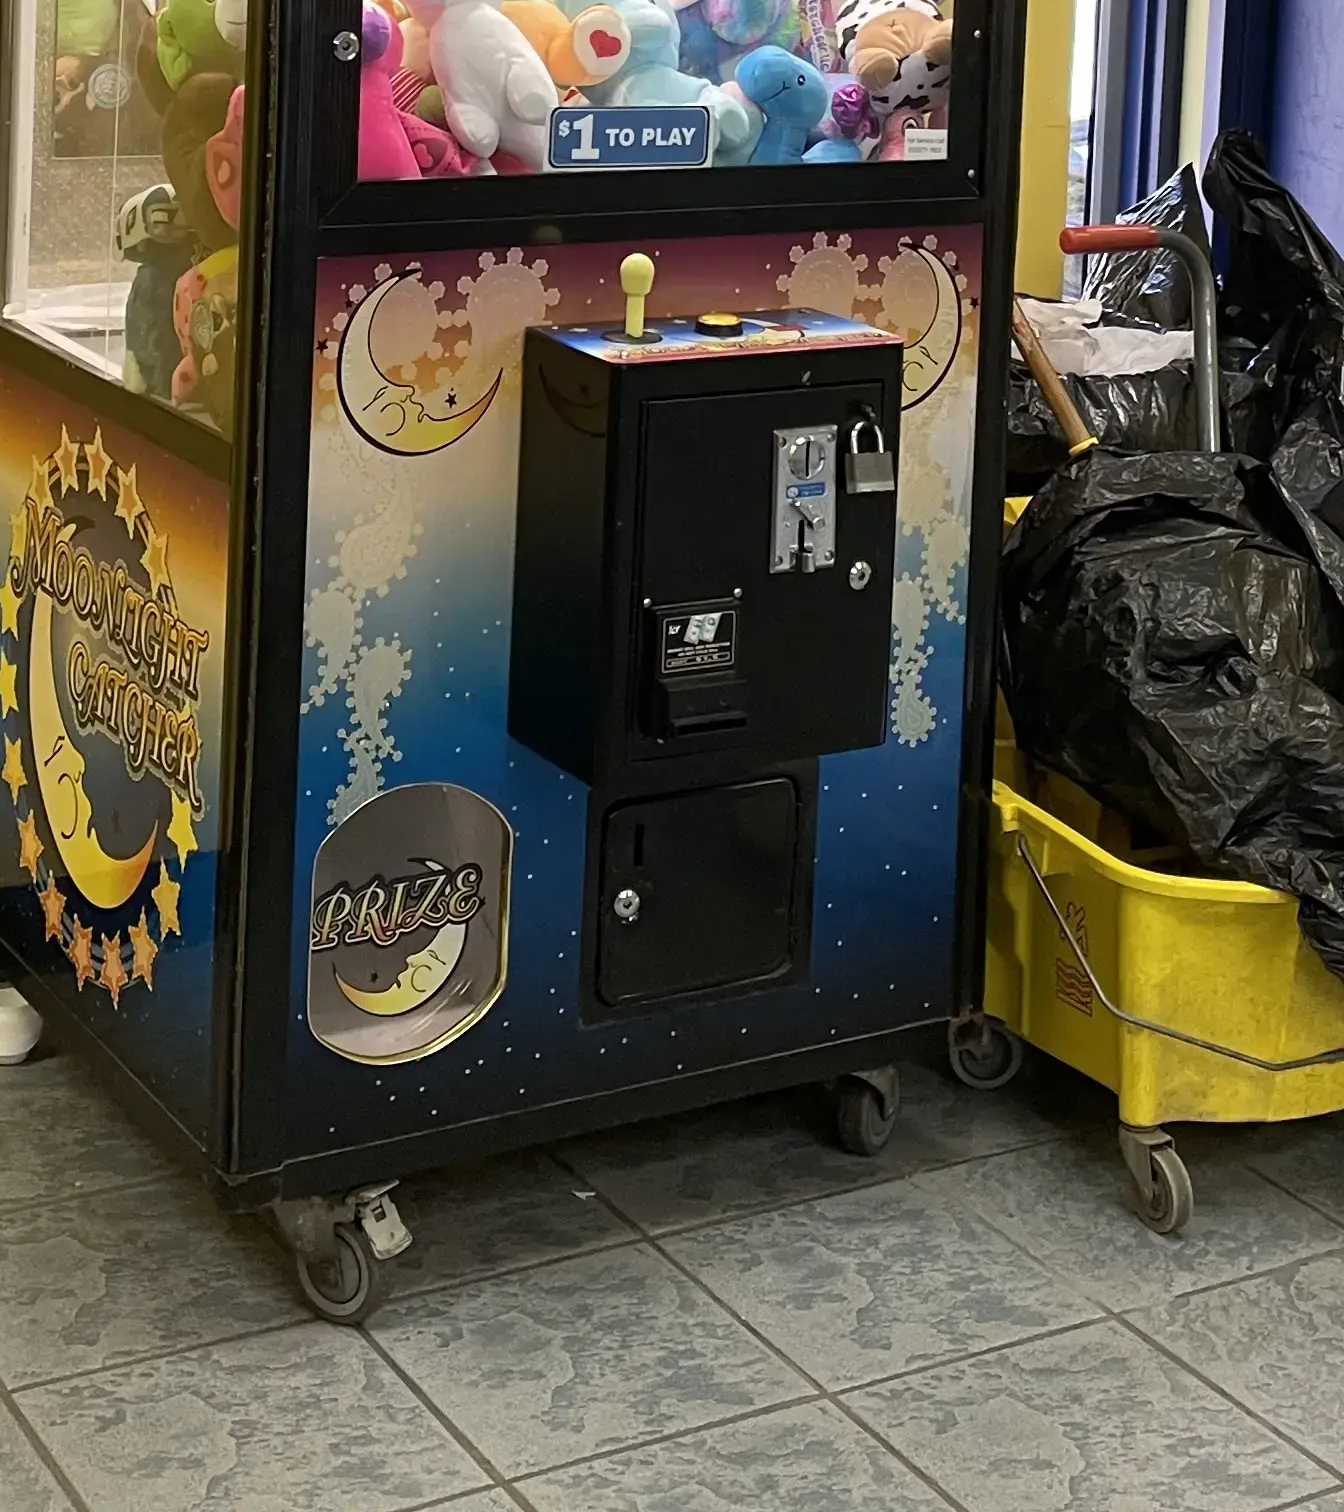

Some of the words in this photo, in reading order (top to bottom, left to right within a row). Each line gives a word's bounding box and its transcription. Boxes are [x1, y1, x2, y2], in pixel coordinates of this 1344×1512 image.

[558, 113, 600, 160] $1
[605, 128, 635, 147] TO
[641, 127, 696, 147] PLAY
[11, 498, 209, 700] MOONLIGHT
[67, 641, 201, 810] CATCHER
[311, 863, 482, 949] PRIZE
